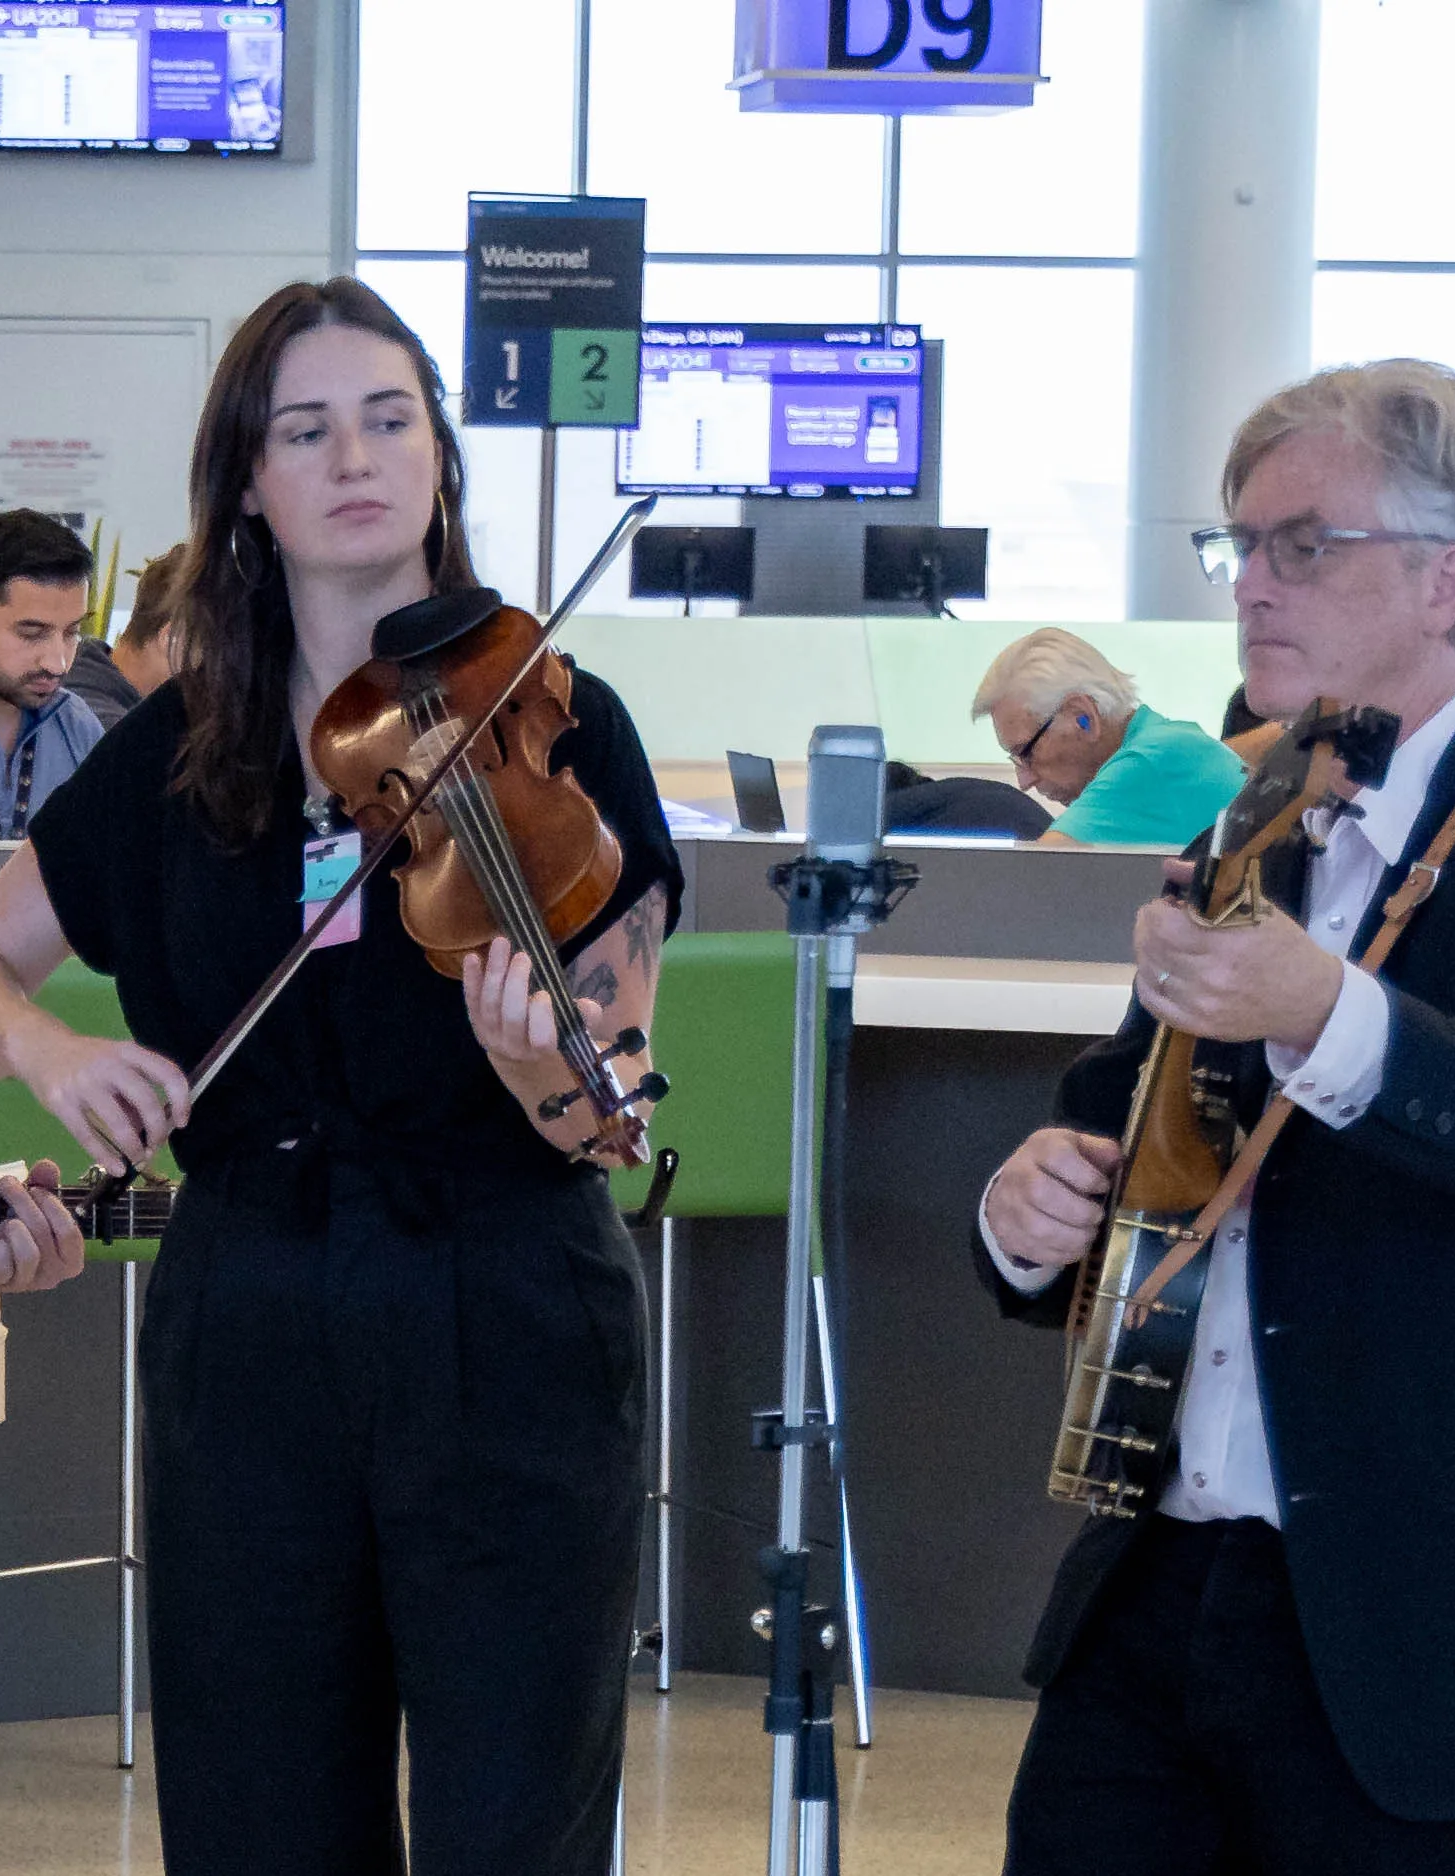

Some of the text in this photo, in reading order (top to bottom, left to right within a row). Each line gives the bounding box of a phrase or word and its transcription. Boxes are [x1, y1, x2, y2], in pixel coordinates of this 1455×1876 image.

[829, 0, 994, 71] D9
[481, 245, 590, 268] Welcome!
[501, 340, 519, 381] 1
[580, 343, 609, 382] 2
